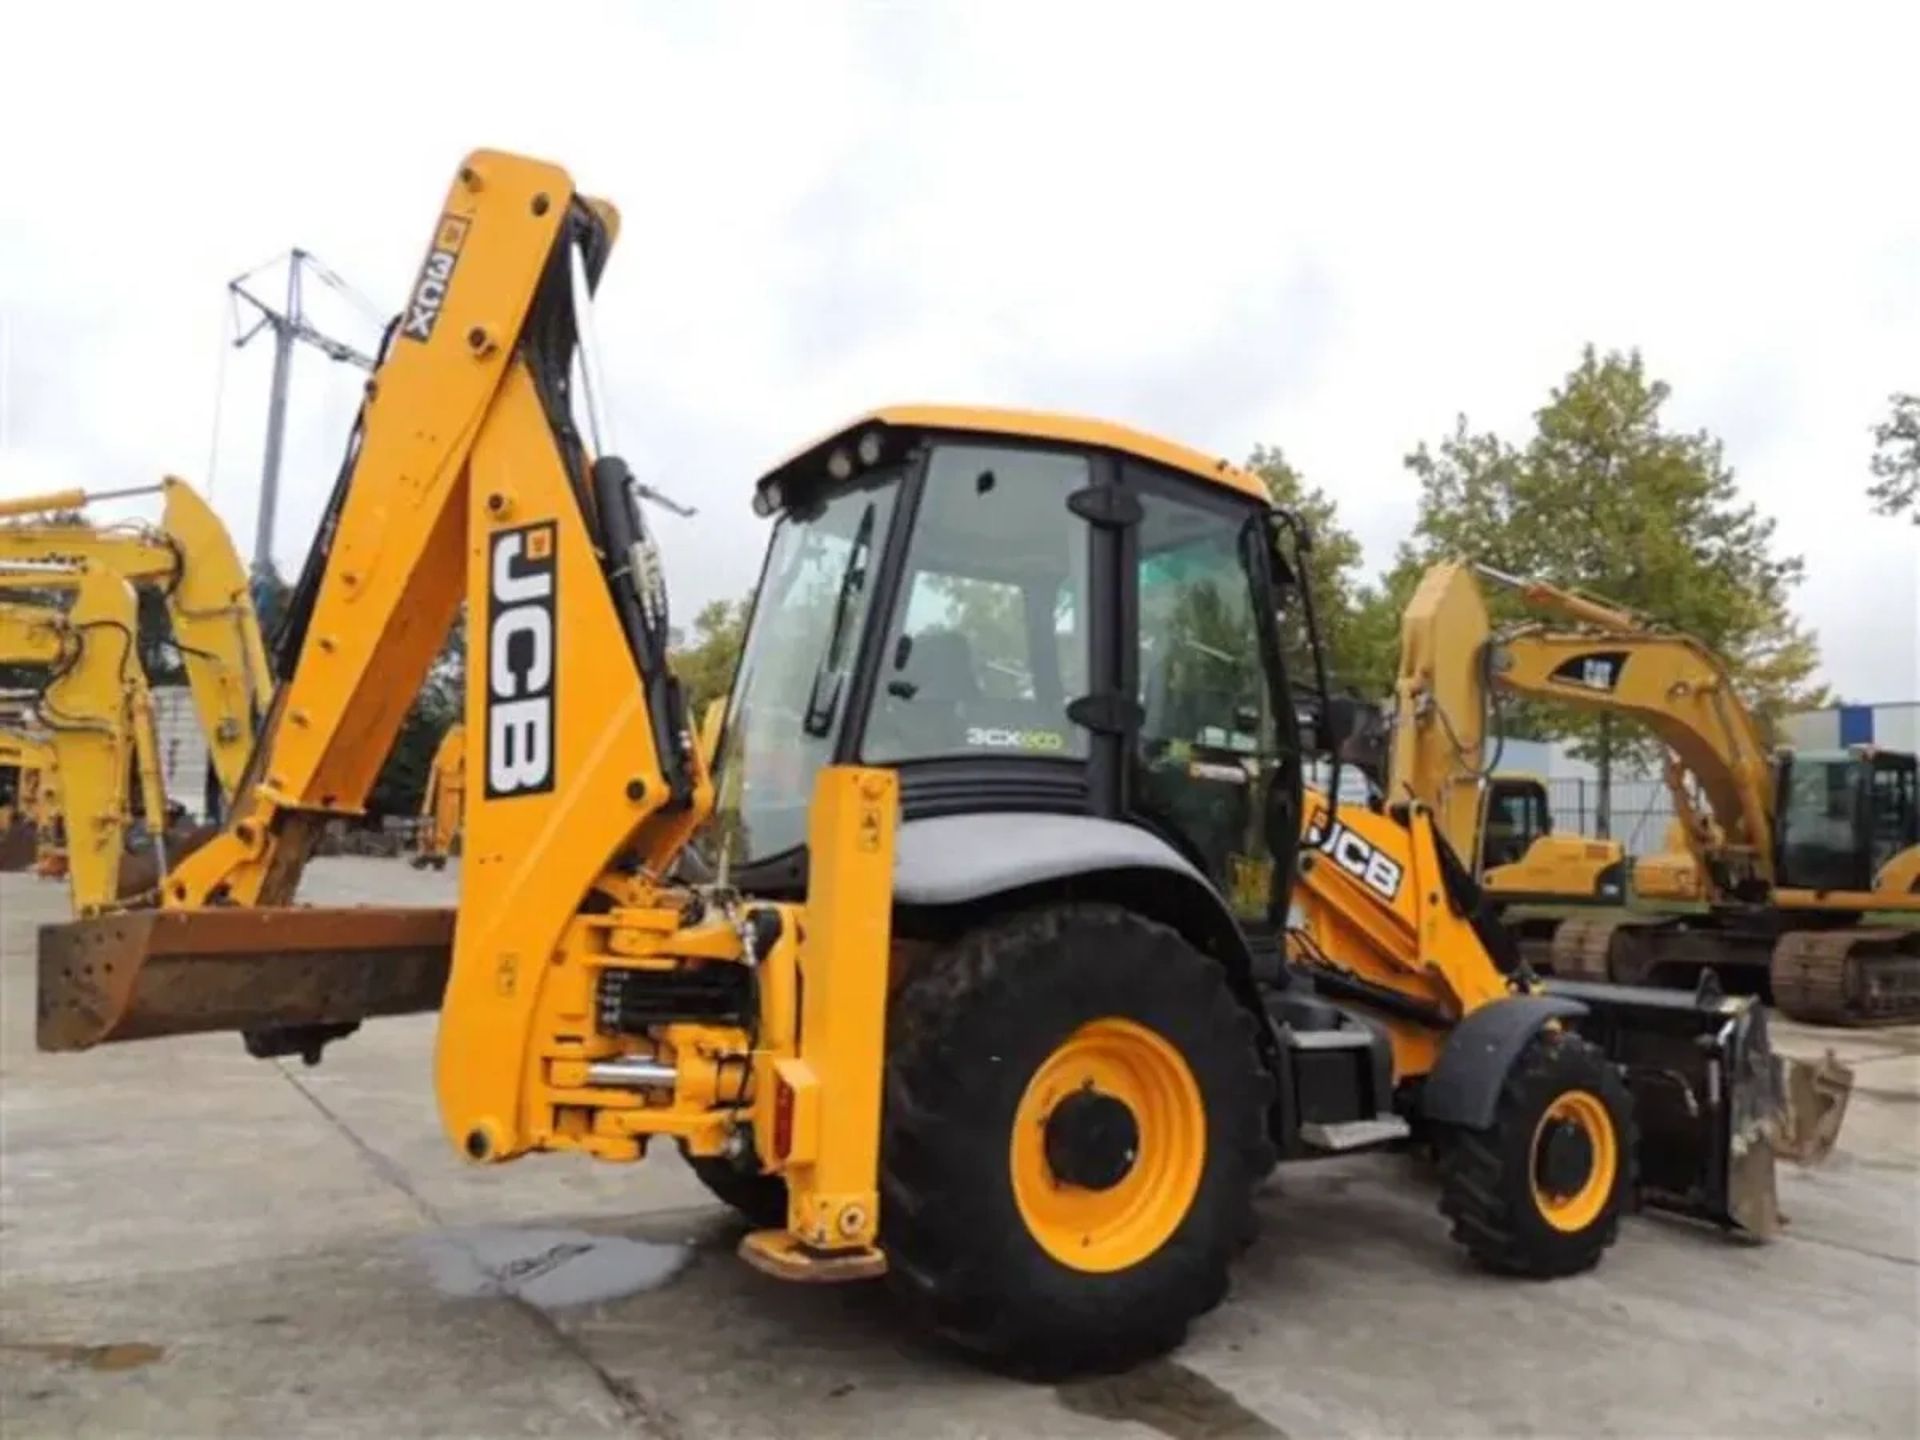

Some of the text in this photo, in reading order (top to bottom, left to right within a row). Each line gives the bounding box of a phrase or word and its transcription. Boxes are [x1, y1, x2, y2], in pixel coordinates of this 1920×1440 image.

[405, 251, 455, 337] 3CX
[489, 531, 551, 794] JCB
[1308, 822, 1401, 898] JCB
